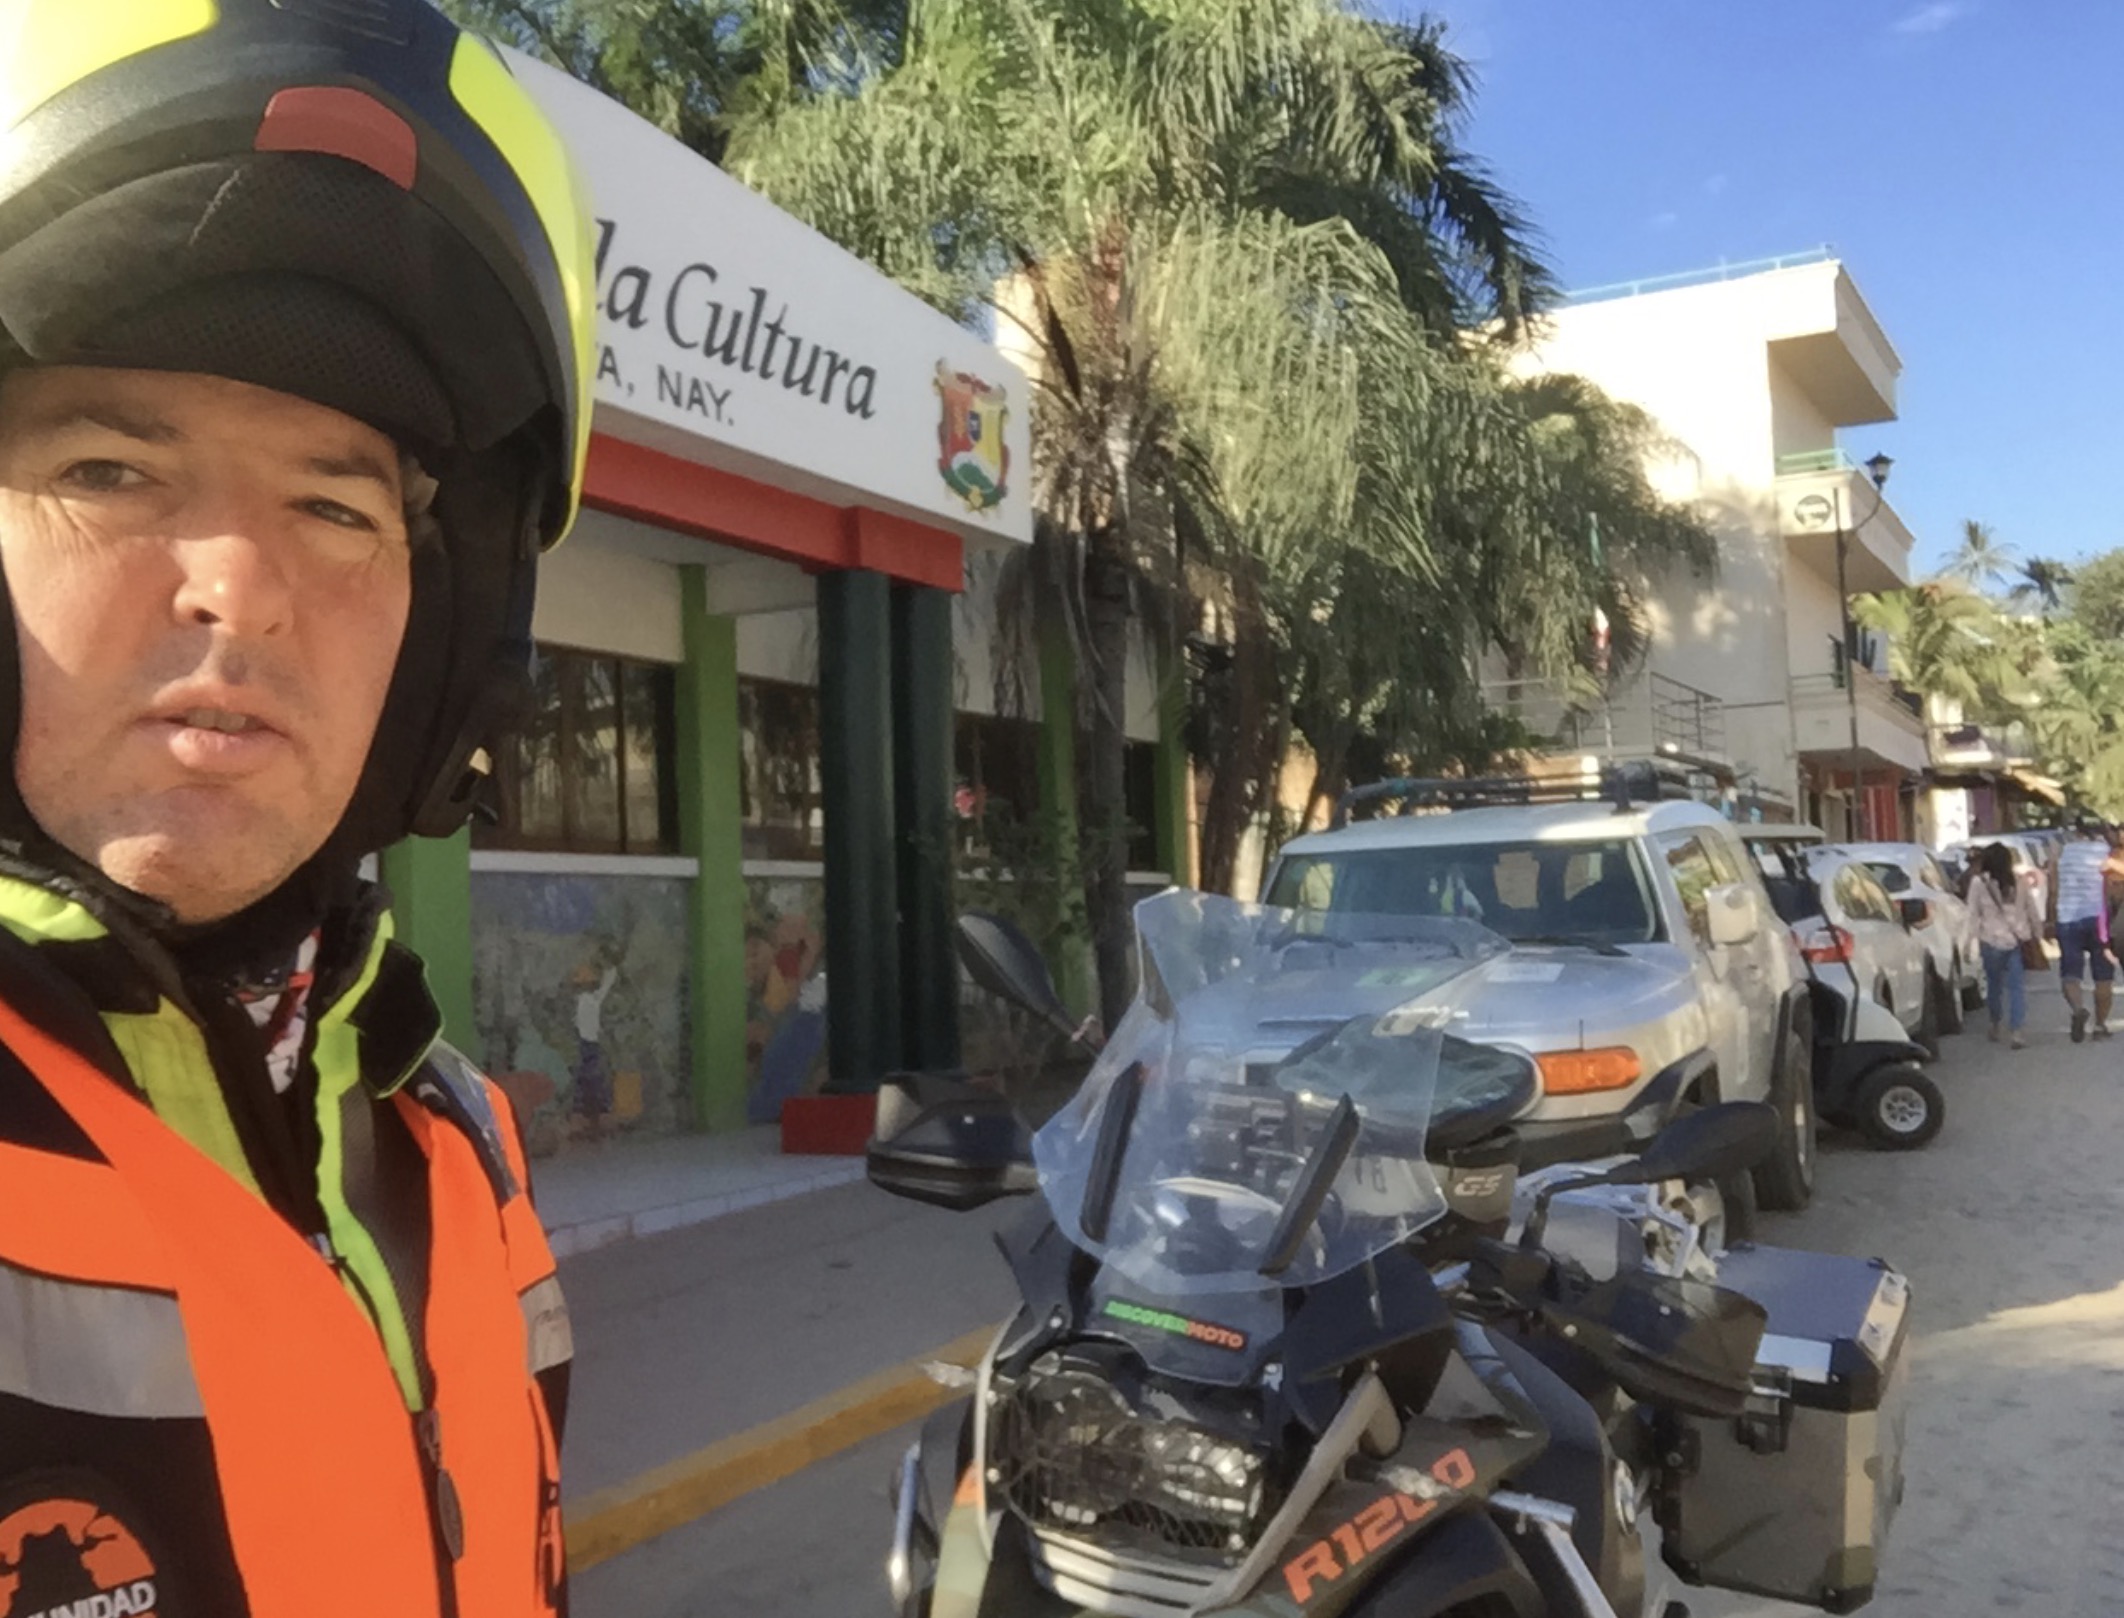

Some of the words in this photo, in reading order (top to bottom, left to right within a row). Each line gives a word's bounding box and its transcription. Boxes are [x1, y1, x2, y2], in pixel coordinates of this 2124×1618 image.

[595, 217, 652, 330] la
[665, 262, 877, 420] Cultura
[595, 343, 635, 396] A,
[656, 363, 735, 427] NAY.
[1453, 1174, 1503, 1197] GS
